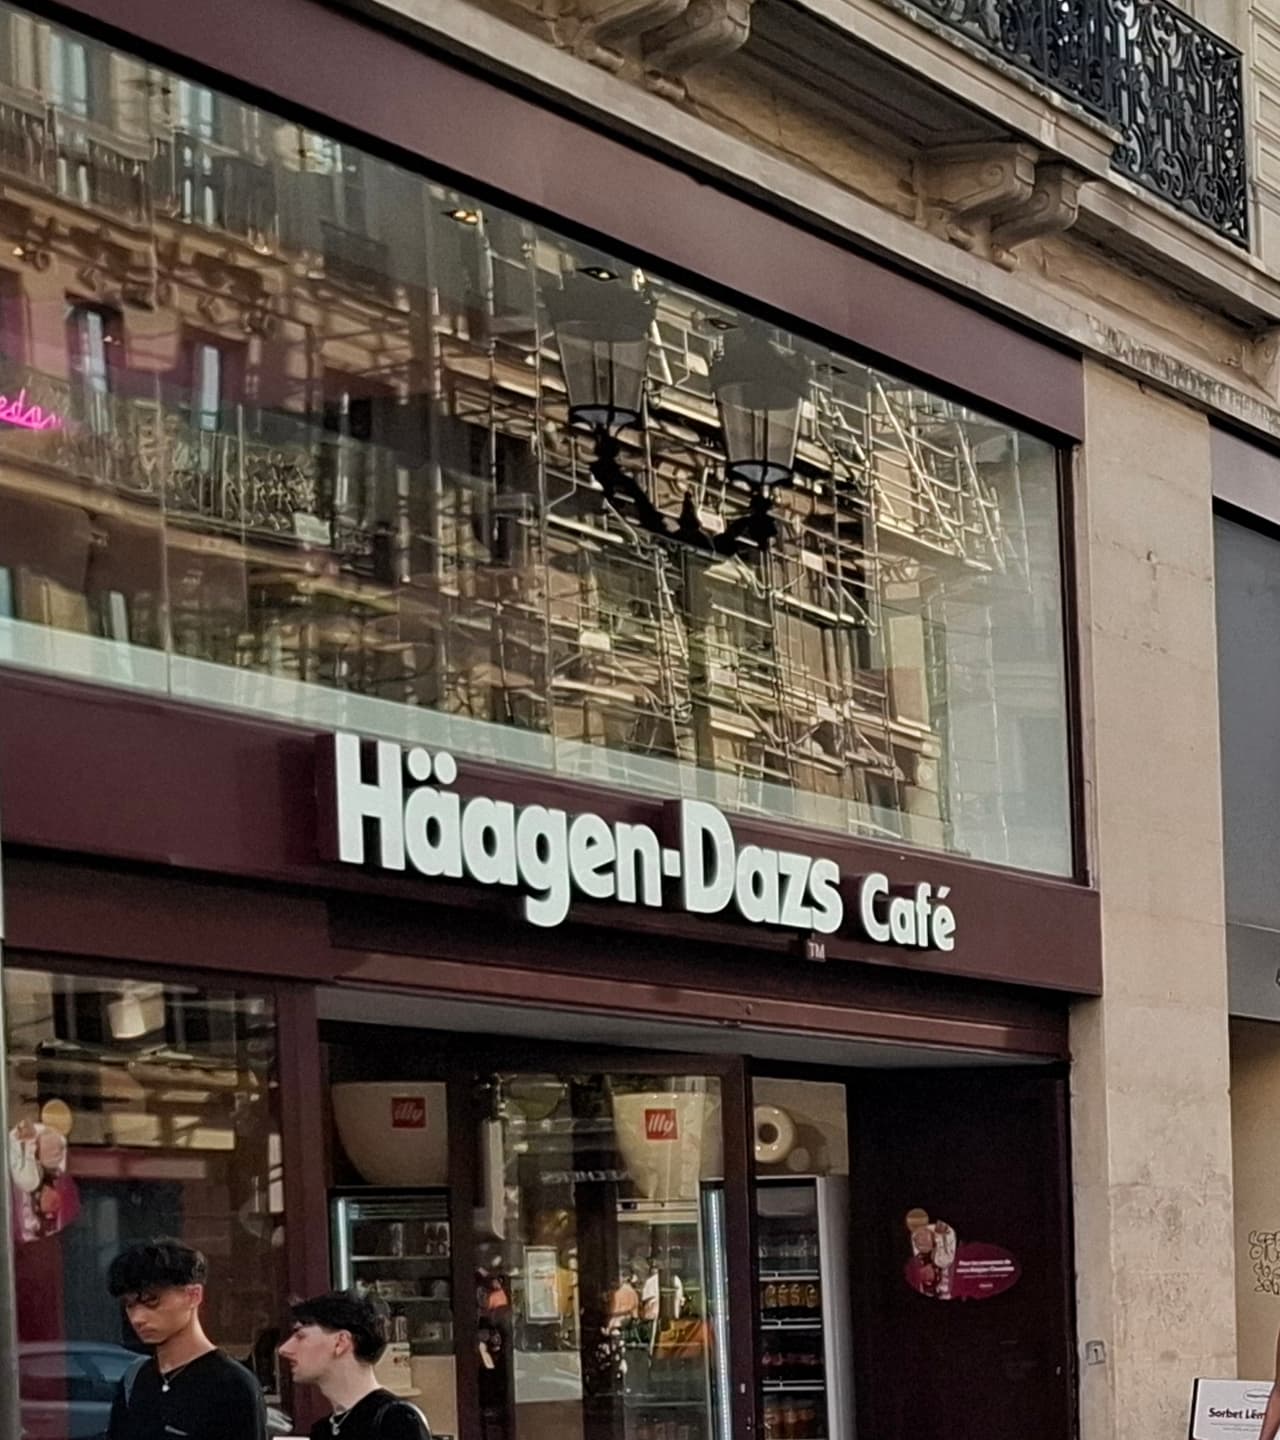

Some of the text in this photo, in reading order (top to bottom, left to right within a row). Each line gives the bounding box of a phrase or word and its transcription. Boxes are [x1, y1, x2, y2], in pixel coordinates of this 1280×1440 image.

[335, 731, 956, 952] Häagen-Dazs Café
[394, 1102, 423, 1122] illy
[649, 1112, 674, 1134] illy
[1208, 1407, 1243, 1419] Sorbet
